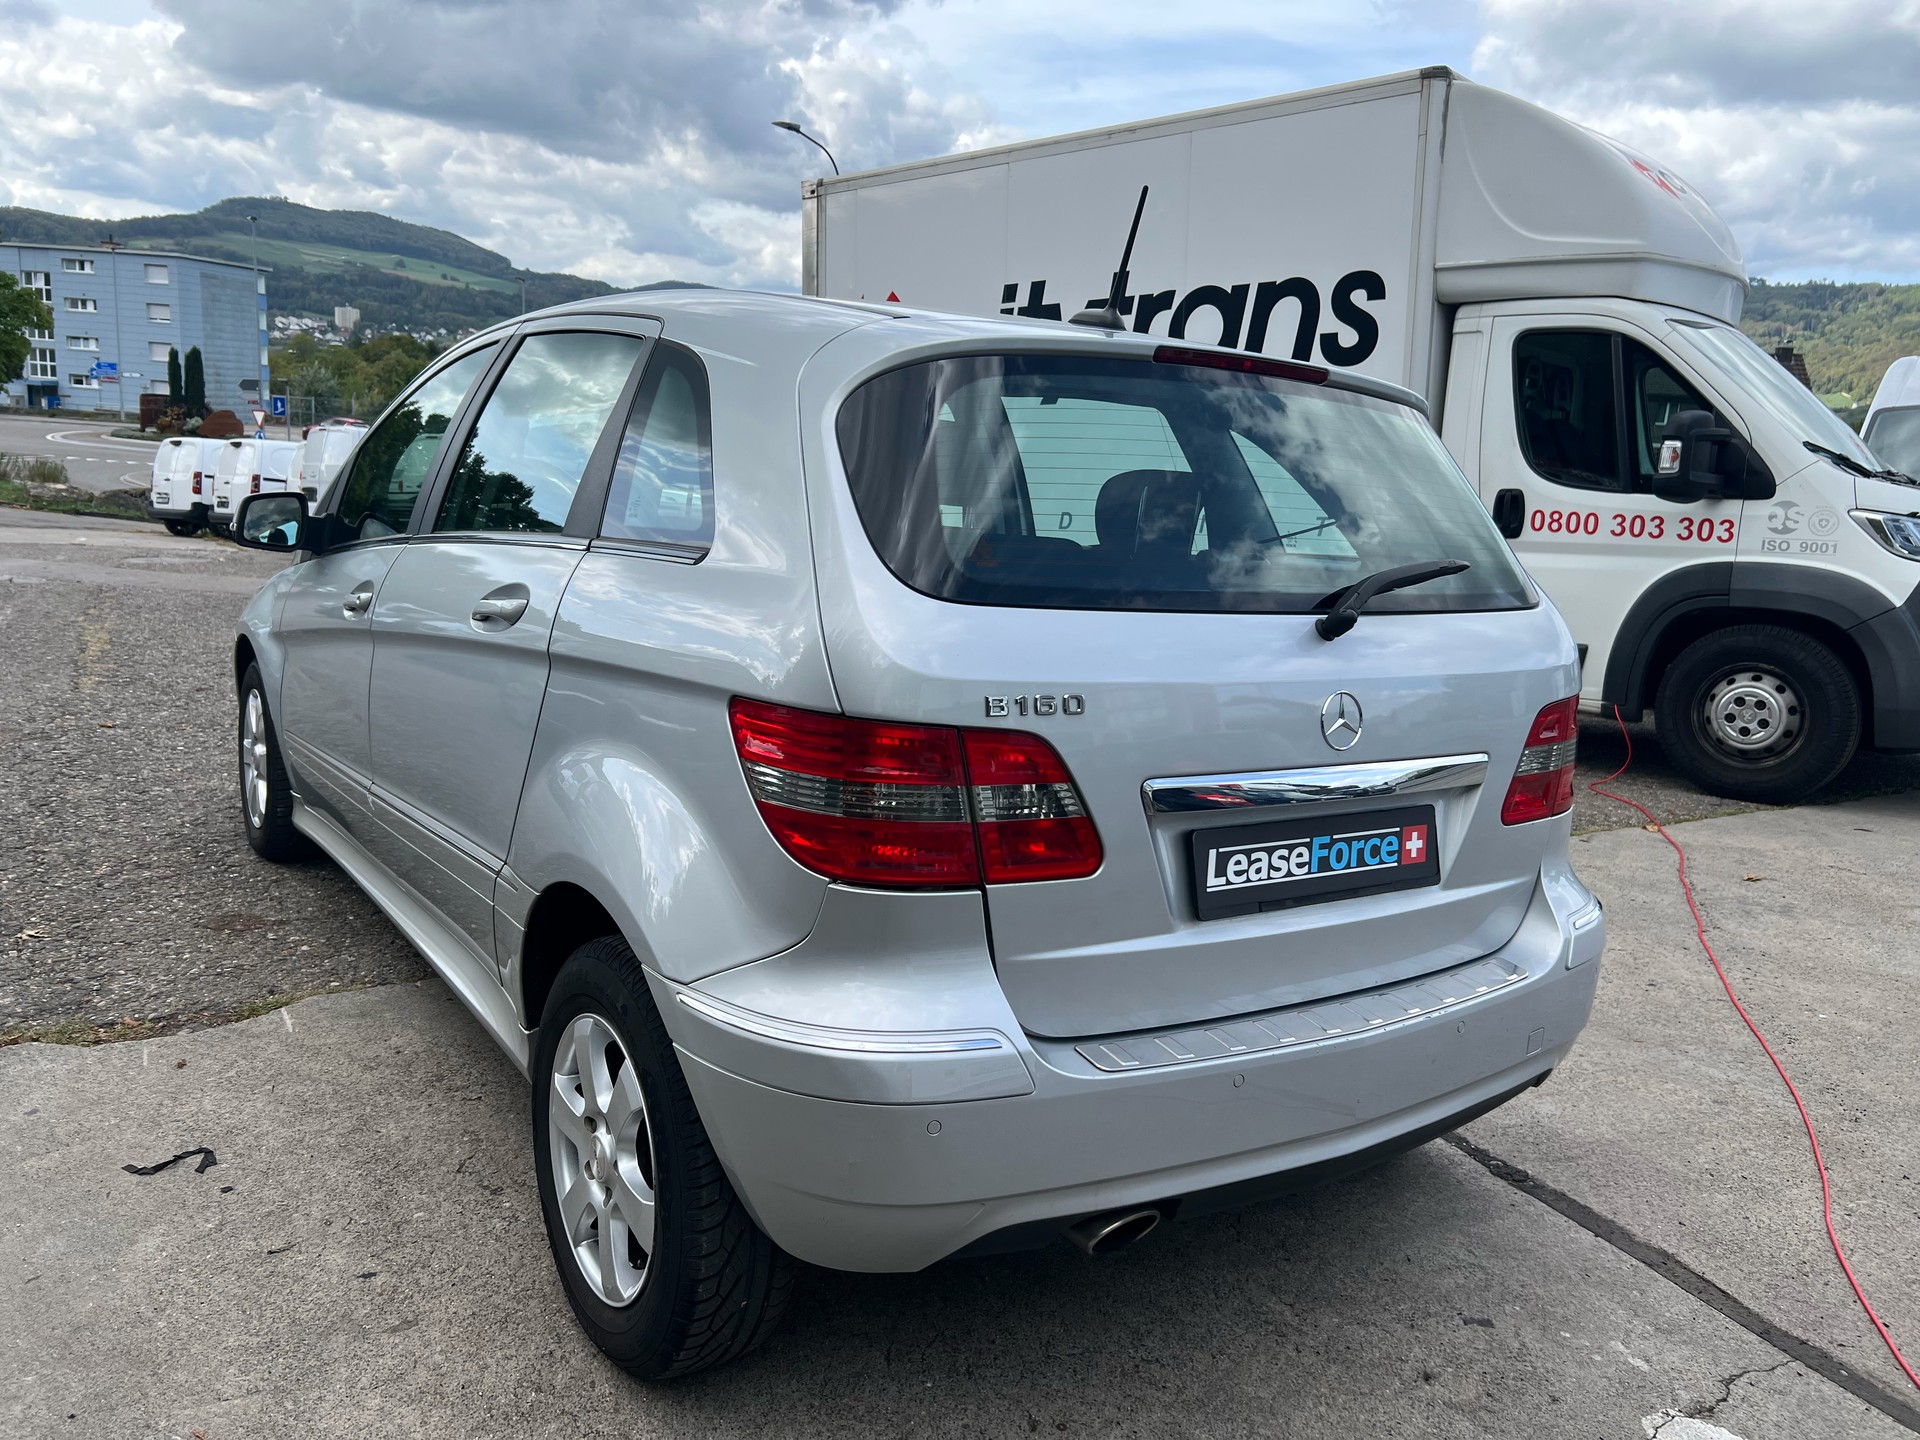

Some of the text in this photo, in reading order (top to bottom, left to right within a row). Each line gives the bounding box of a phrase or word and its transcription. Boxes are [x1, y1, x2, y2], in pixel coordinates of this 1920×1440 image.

[1530, 509, 1735, 543] 0800 303 303
[1761, 540, 1838, 554] ISO 9001
[985, 694, 1085, 717] B160
[1206, 835, 1399, 887] LeaseForce
